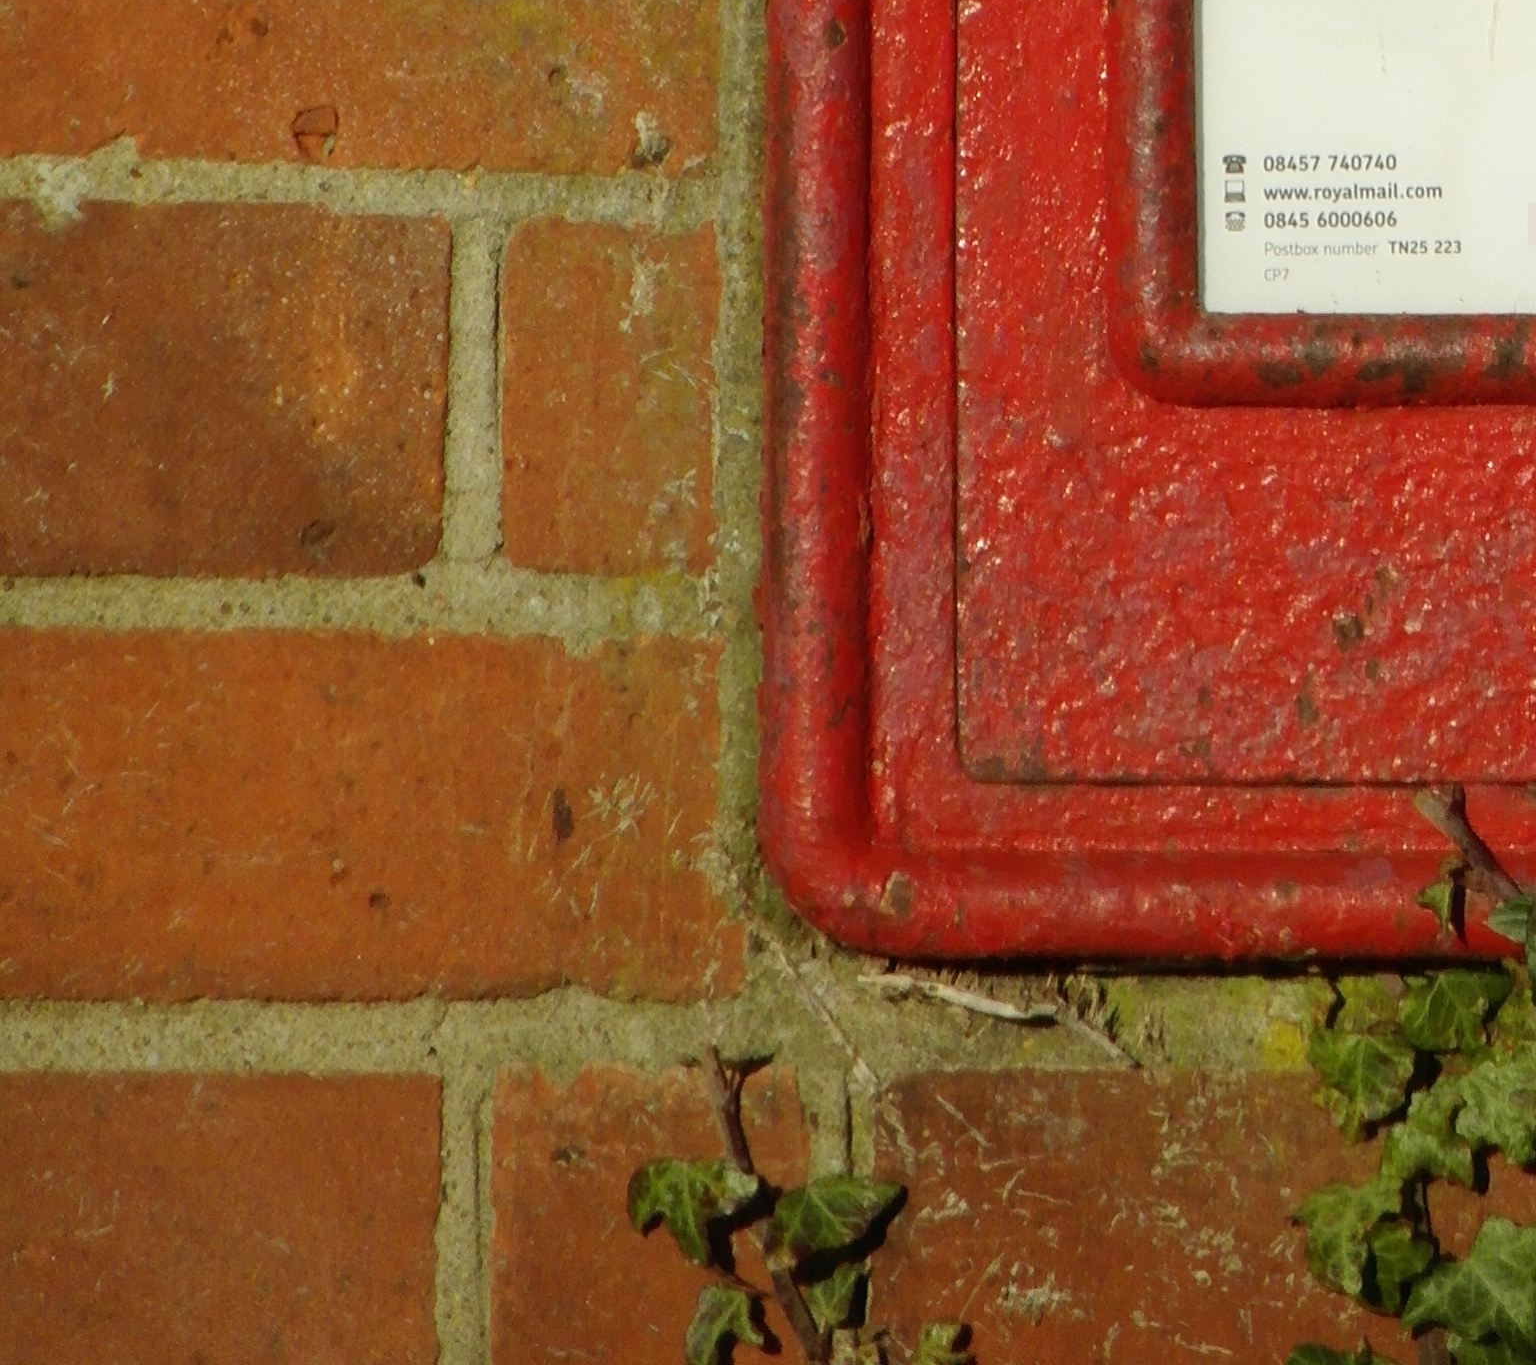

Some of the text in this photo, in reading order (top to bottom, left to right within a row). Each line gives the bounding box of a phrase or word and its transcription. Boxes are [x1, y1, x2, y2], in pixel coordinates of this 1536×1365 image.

[1263, 154, 1398, 173] 08457 740740
[1263, 182, 1443, 204] www.royalmail.com
[1263, 210, 1398, 229] 0845 6000606
[1264, 239, 1463, 257] Postbox number TN25 223
[1263, 268, 1290, 282] CP7
